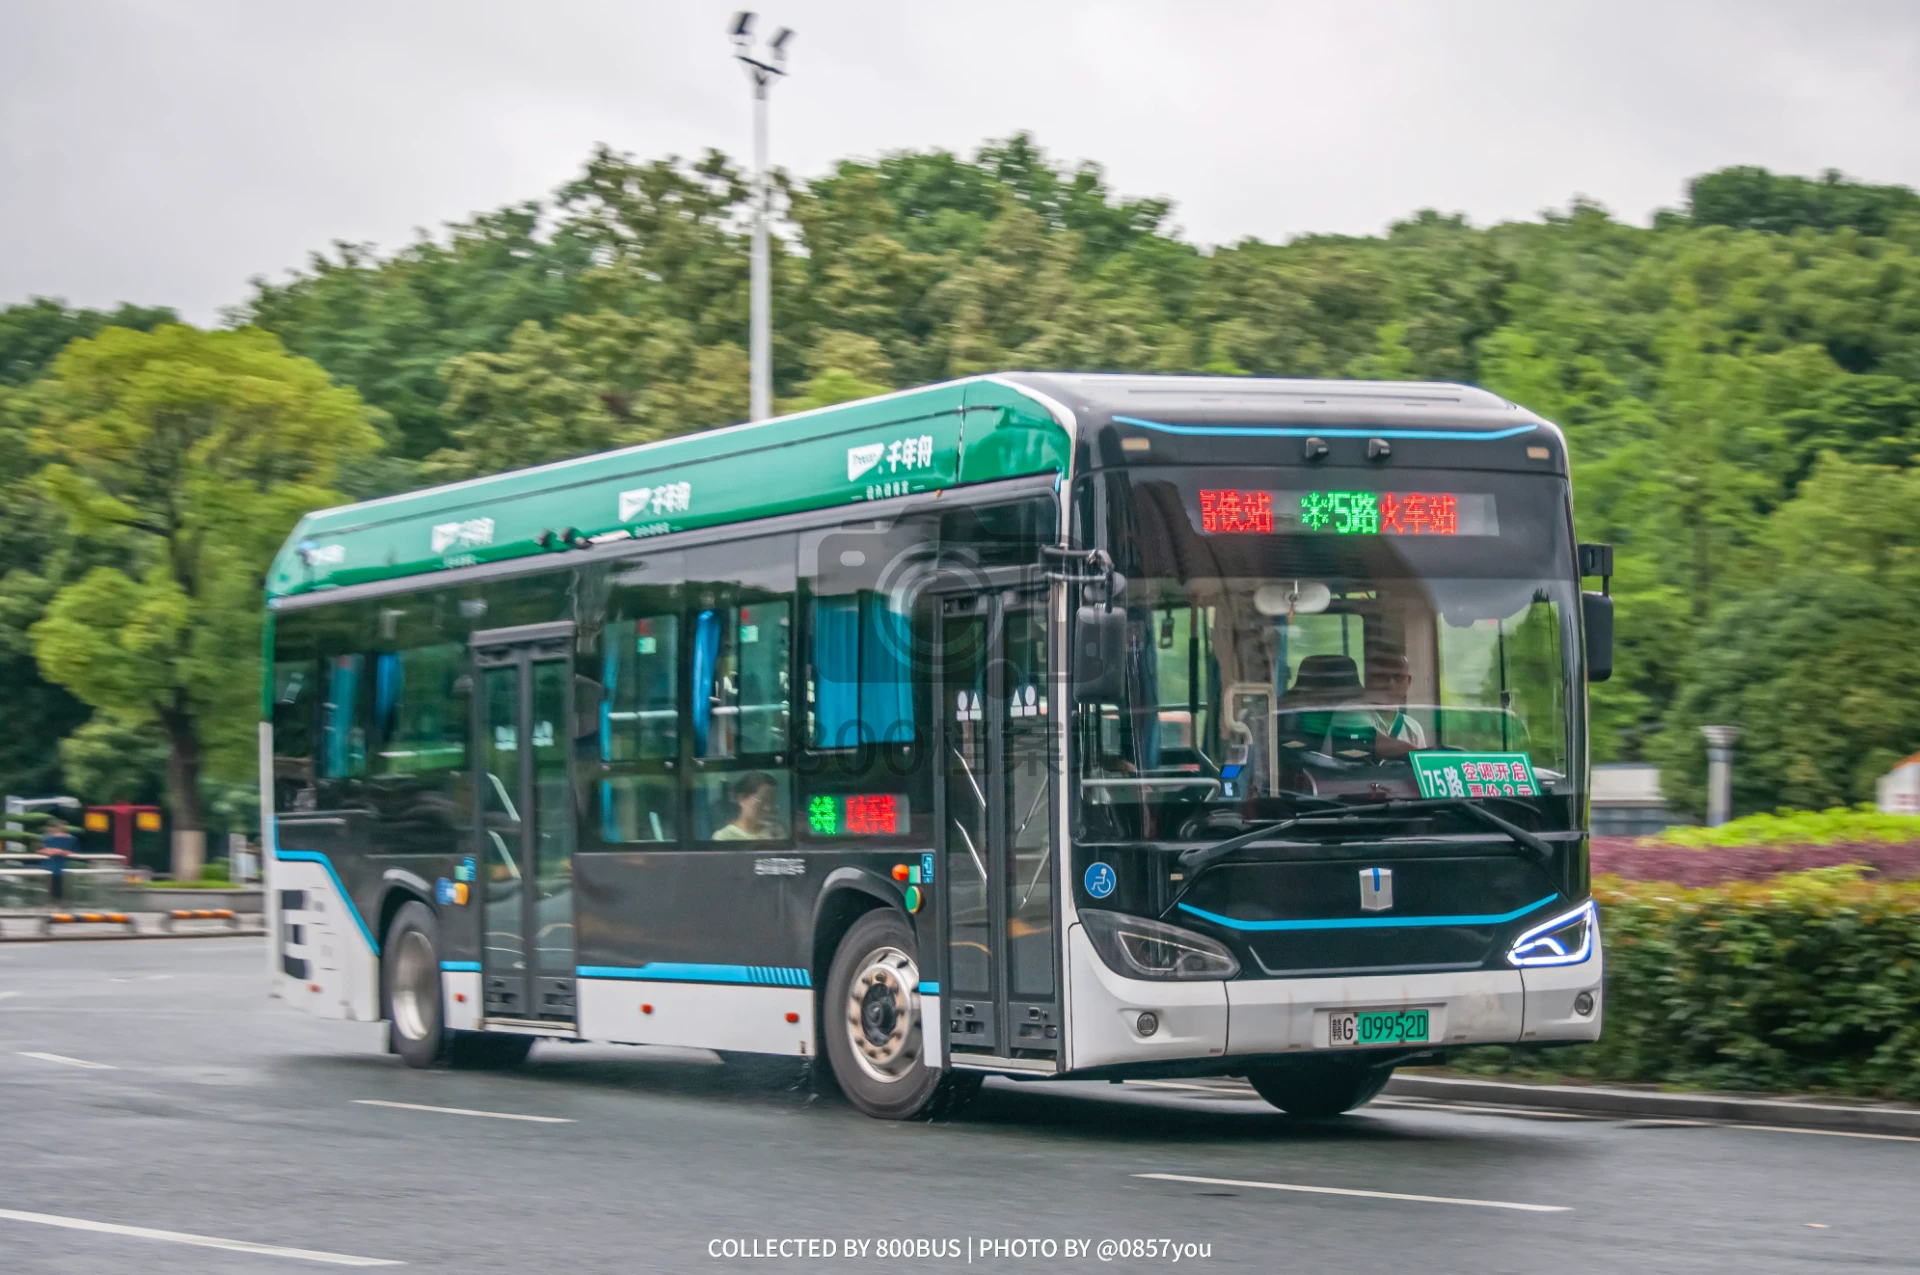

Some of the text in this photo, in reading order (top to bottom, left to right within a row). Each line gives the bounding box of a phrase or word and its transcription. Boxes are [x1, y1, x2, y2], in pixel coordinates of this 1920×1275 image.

[1379, 493, 1457, 534] 火车站
[1462, 761, 1528, 783] 空调开启
